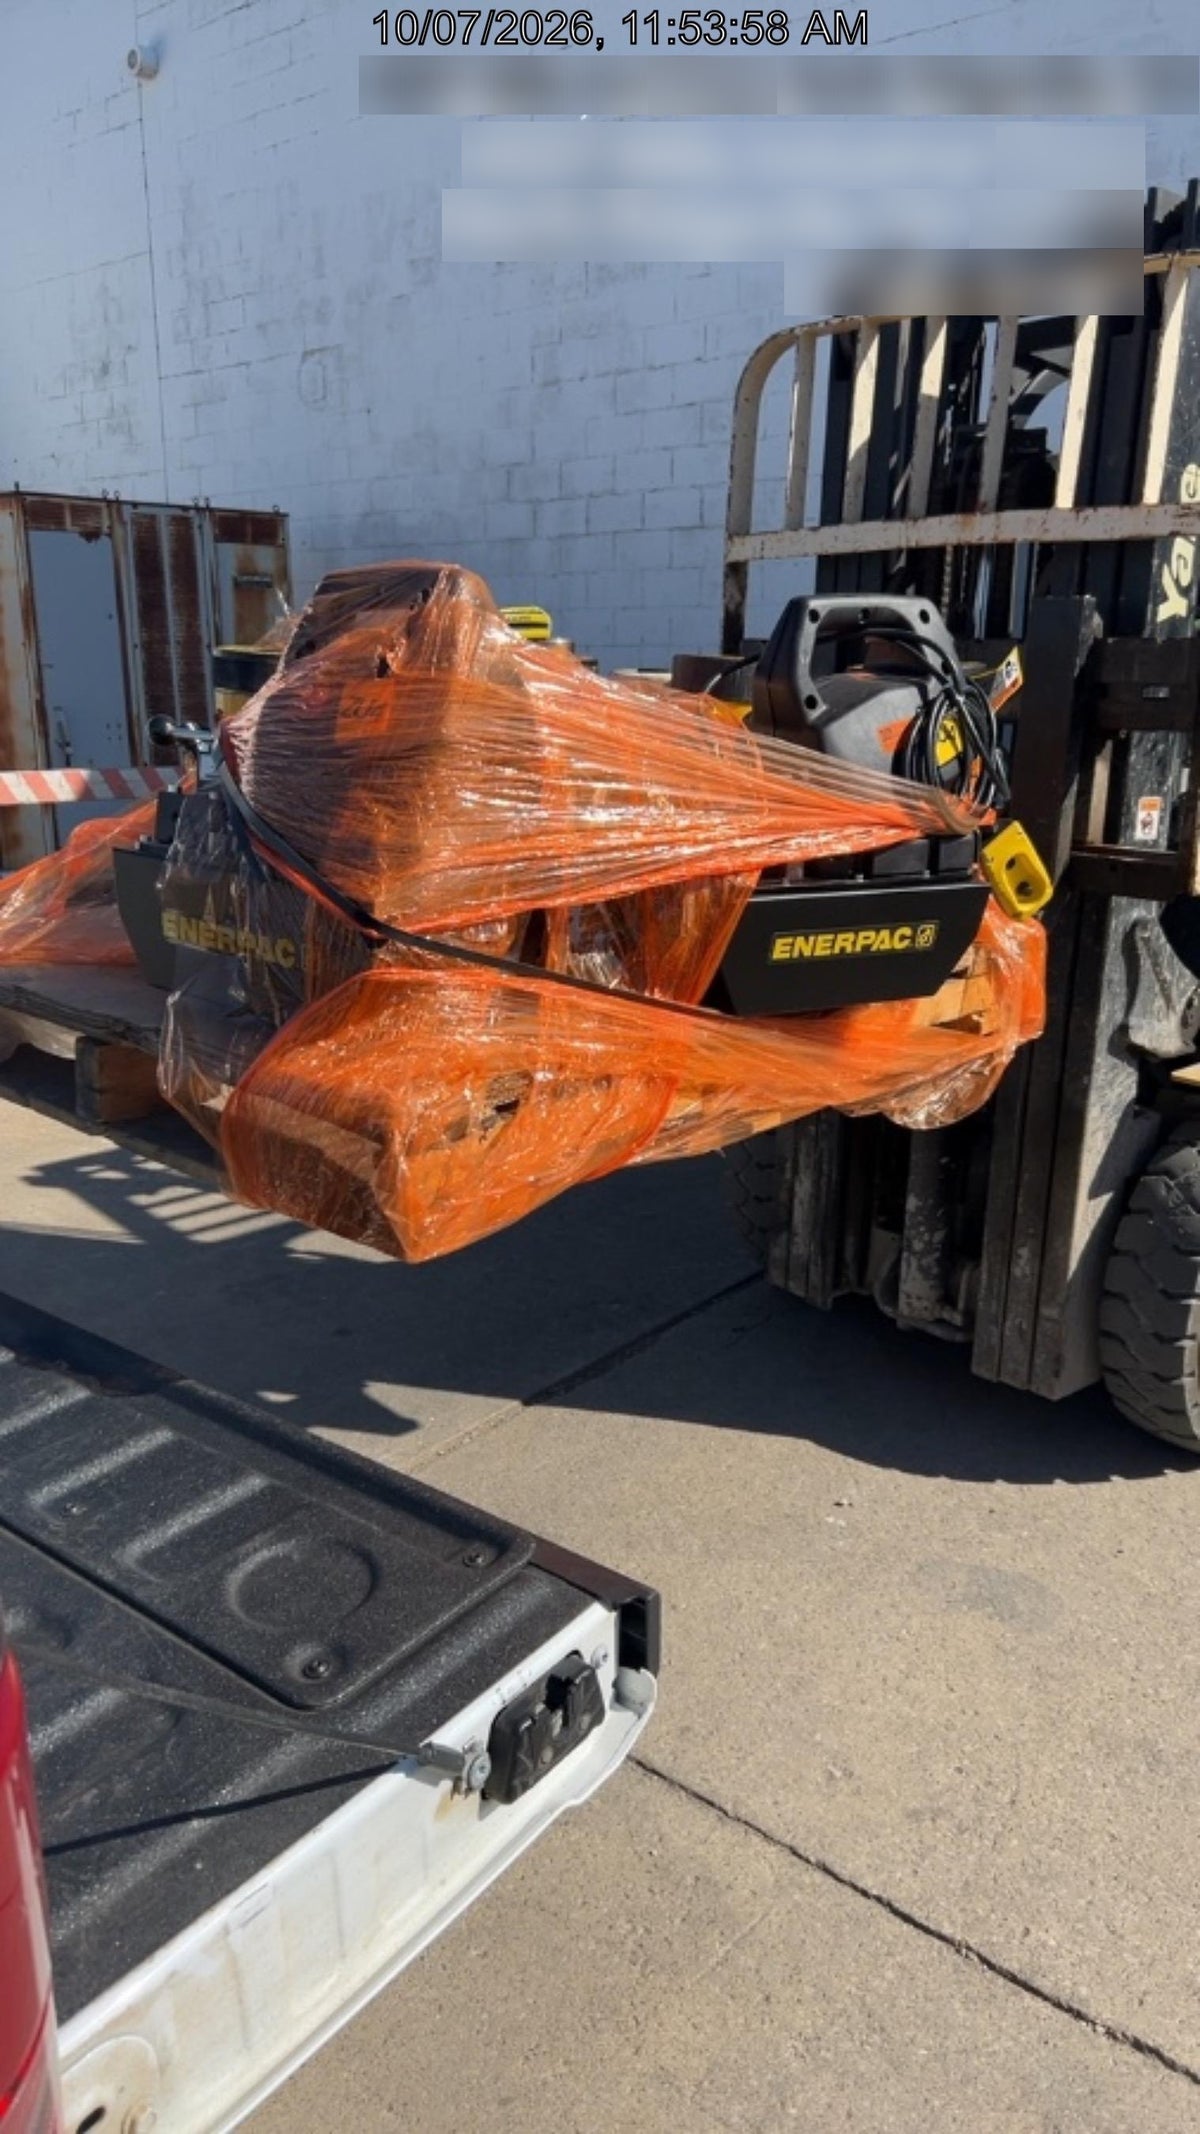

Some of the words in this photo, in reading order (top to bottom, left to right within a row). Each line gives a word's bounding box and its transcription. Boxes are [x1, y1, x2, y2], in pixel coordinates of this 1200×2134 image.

[1156, 463, 1200, 623] Yae
[162, 907, 296, 969] ENERPAC
[772, 926, 912, 960] ENERPAC
